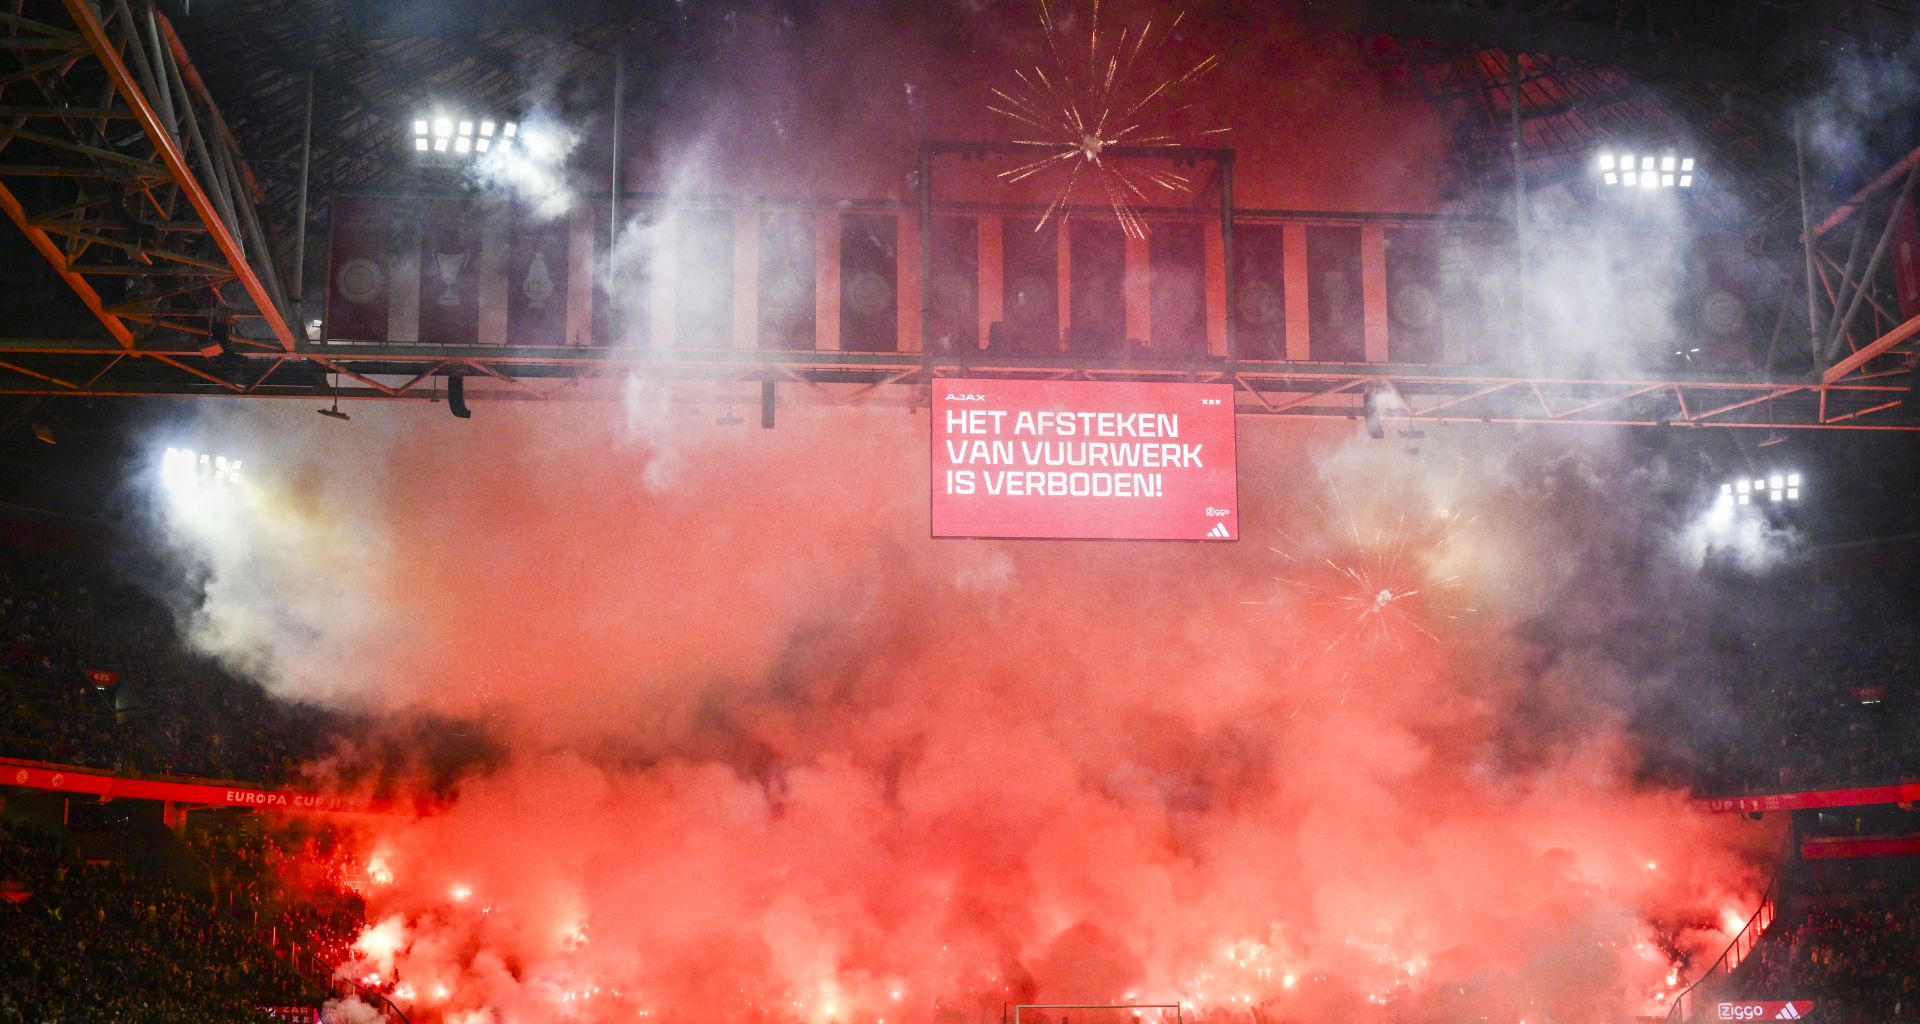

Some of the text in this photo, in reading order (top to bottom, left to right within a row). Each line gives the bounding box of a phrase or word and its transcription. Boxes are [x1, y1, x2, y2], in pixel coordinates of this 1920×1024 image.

[945, 393, 986, 401] AJAX
[947, 410, 1178, 437] HET AFSTEKEN
[946, 440, 1204, 468] VAN VUURWERK
[947, 470, 1162, 497] IS VERBODEN!
[226, 791, 287, 805] EUROPA
[293, 795, 325, 807] CUP
